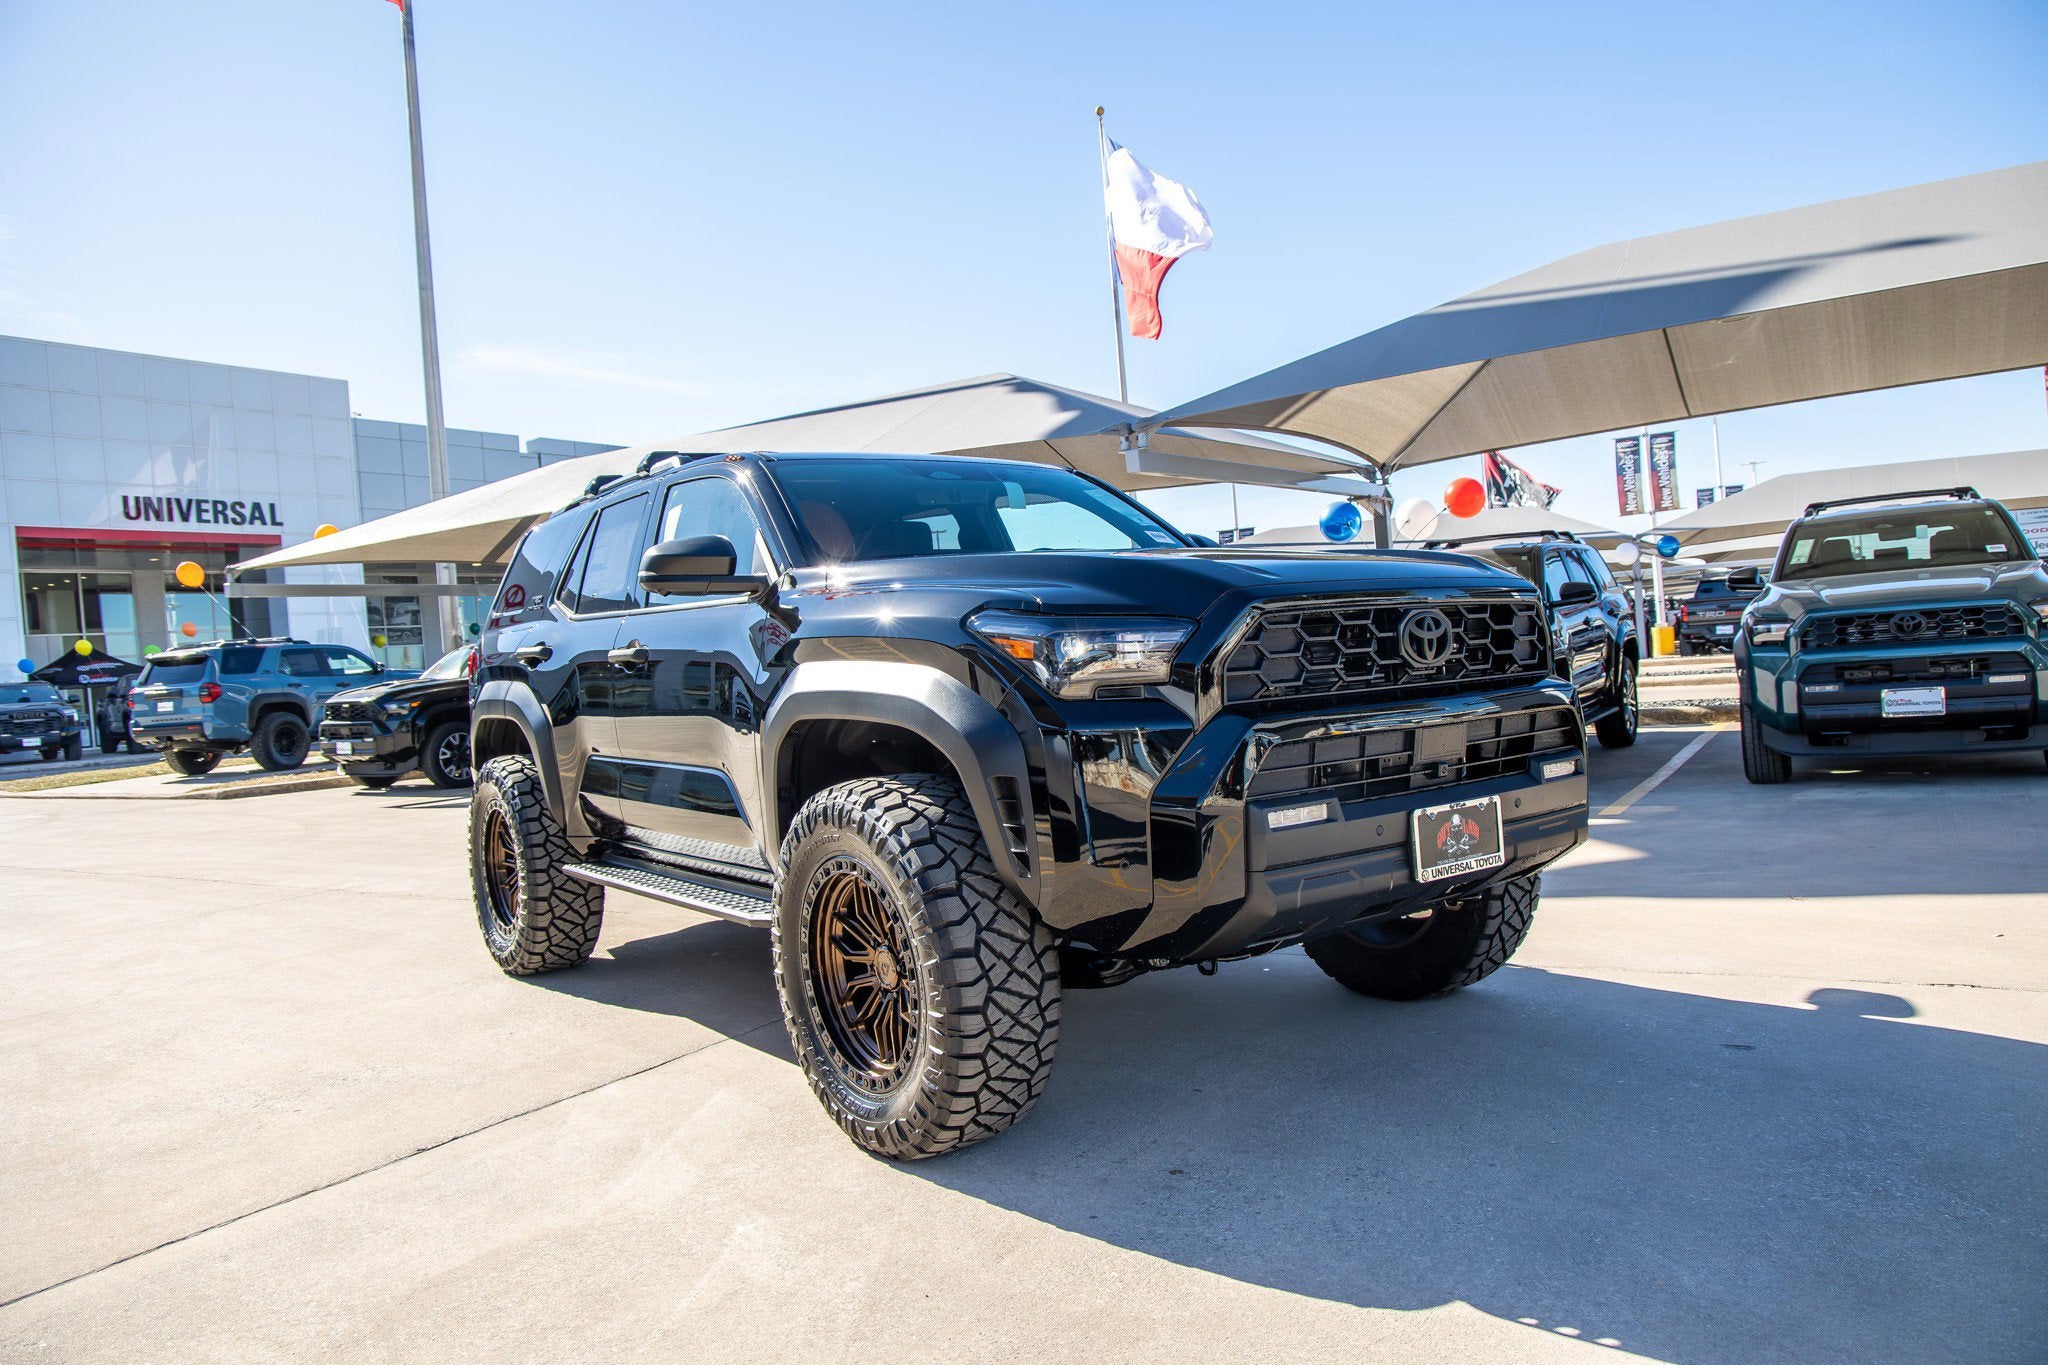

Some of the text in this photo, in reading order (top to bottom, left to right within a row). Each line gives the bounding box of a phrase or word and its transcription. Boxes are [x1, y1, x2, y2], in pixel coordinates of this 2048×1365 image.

[1622, 454, 1636, 492] Vehicles
[1657, 449, 1671, 487] Vehicles
[1625, 491, 1638, 512] New
[1661, 487, 1674, 508] New
[121, 495, 284, 527] UNIVERSAL
[13, 711, 47, 719] TOYOTA
[1431, 861, 1475, 878] UNIVERSAL
[1474, 854, 1502, 868] TOYOTA
